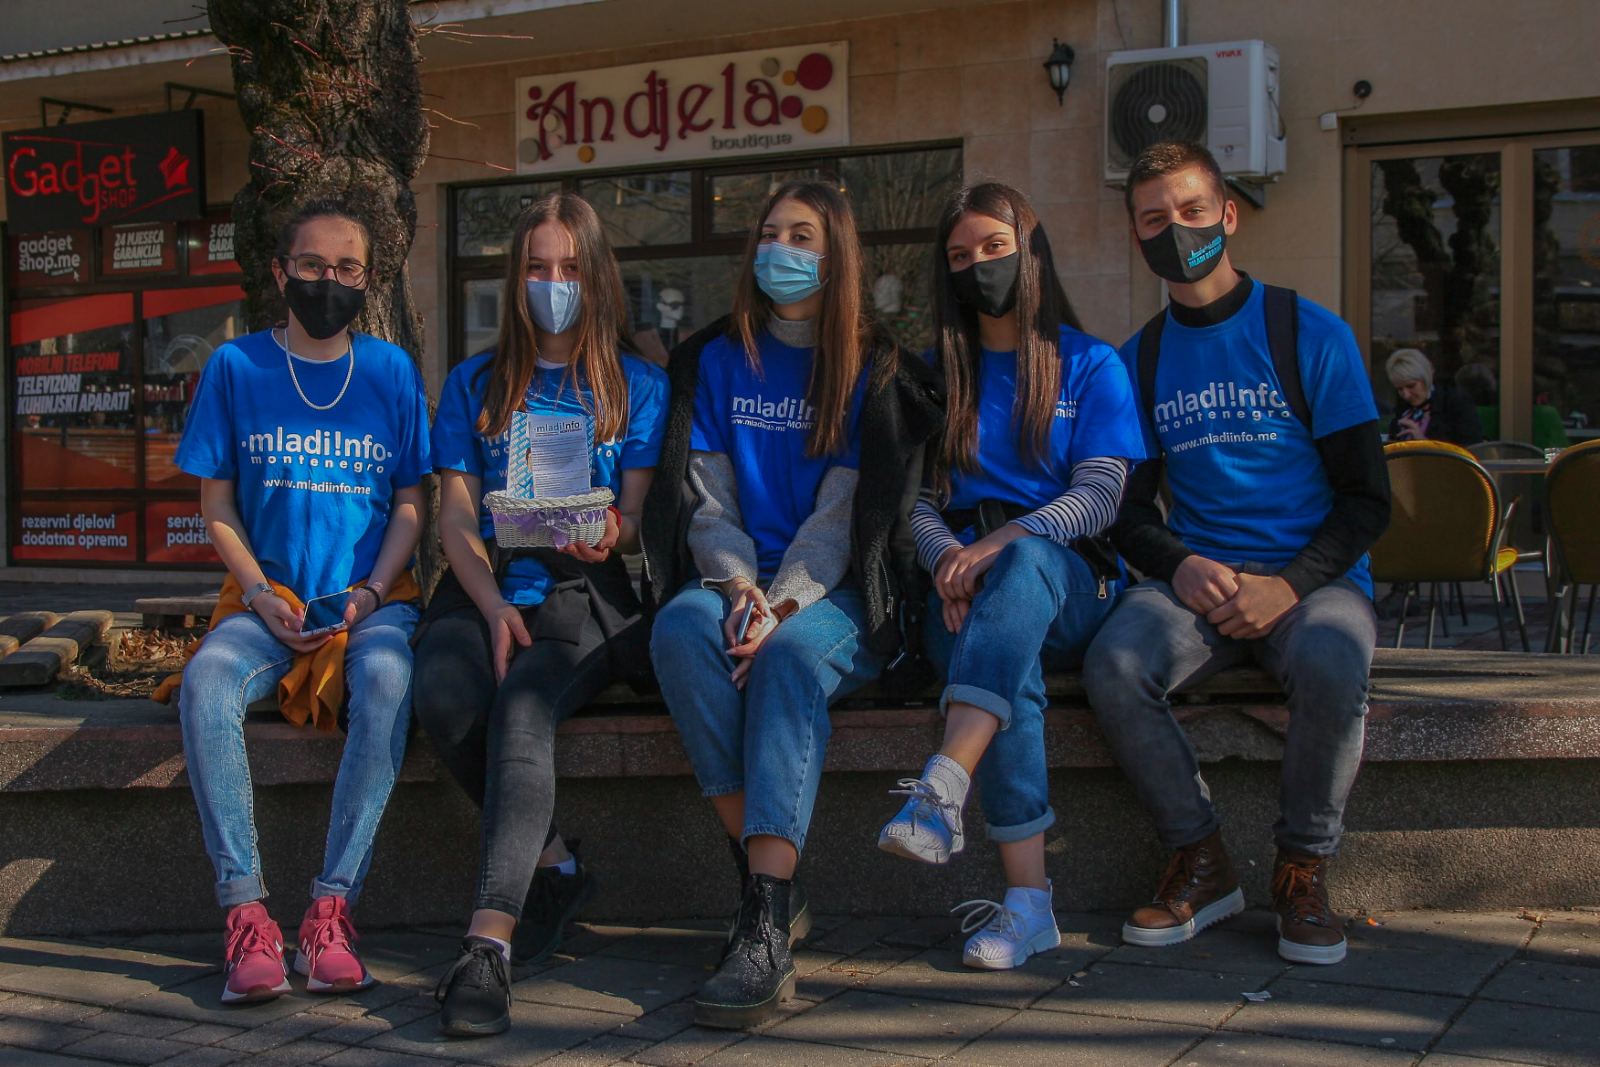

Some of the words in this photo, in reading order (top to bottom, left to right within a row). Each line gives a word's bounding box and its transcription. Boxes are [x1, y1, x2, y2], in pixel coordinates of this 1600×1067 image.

[527, 62, 781, 160] Andjela
[711, 132, 793, 151] boutique
[9, 142, 136, 223] Gadget
[101, 188, 136, 209] SHOP
[19, 235, 72, 258] gadget
[113, 244, 161, 260] GARANCIJA
[19, 254, 80, 274] shop.me
[65, 352, 120, 372] TELEFONI
[17, 374, 81, 394] TELEVIZORI
[17, 394, 78, 414] KUHINJSKI
[79, 391, 130, 412] APARATI
[1159, 409, 1291, 433] montenegro
[1171, 431, 1277, 453] www.mladiinfo.me
[251, 454, 384, 473] montenegro
[263, 479, 371, 495] www.mladiinfo.me
[22, 514, 70, 529] rezervni
[73, 514, 115, 532] djelovi
[22, 531, 75, 546] dodatna
[78, 534, 128, 549] oprema
